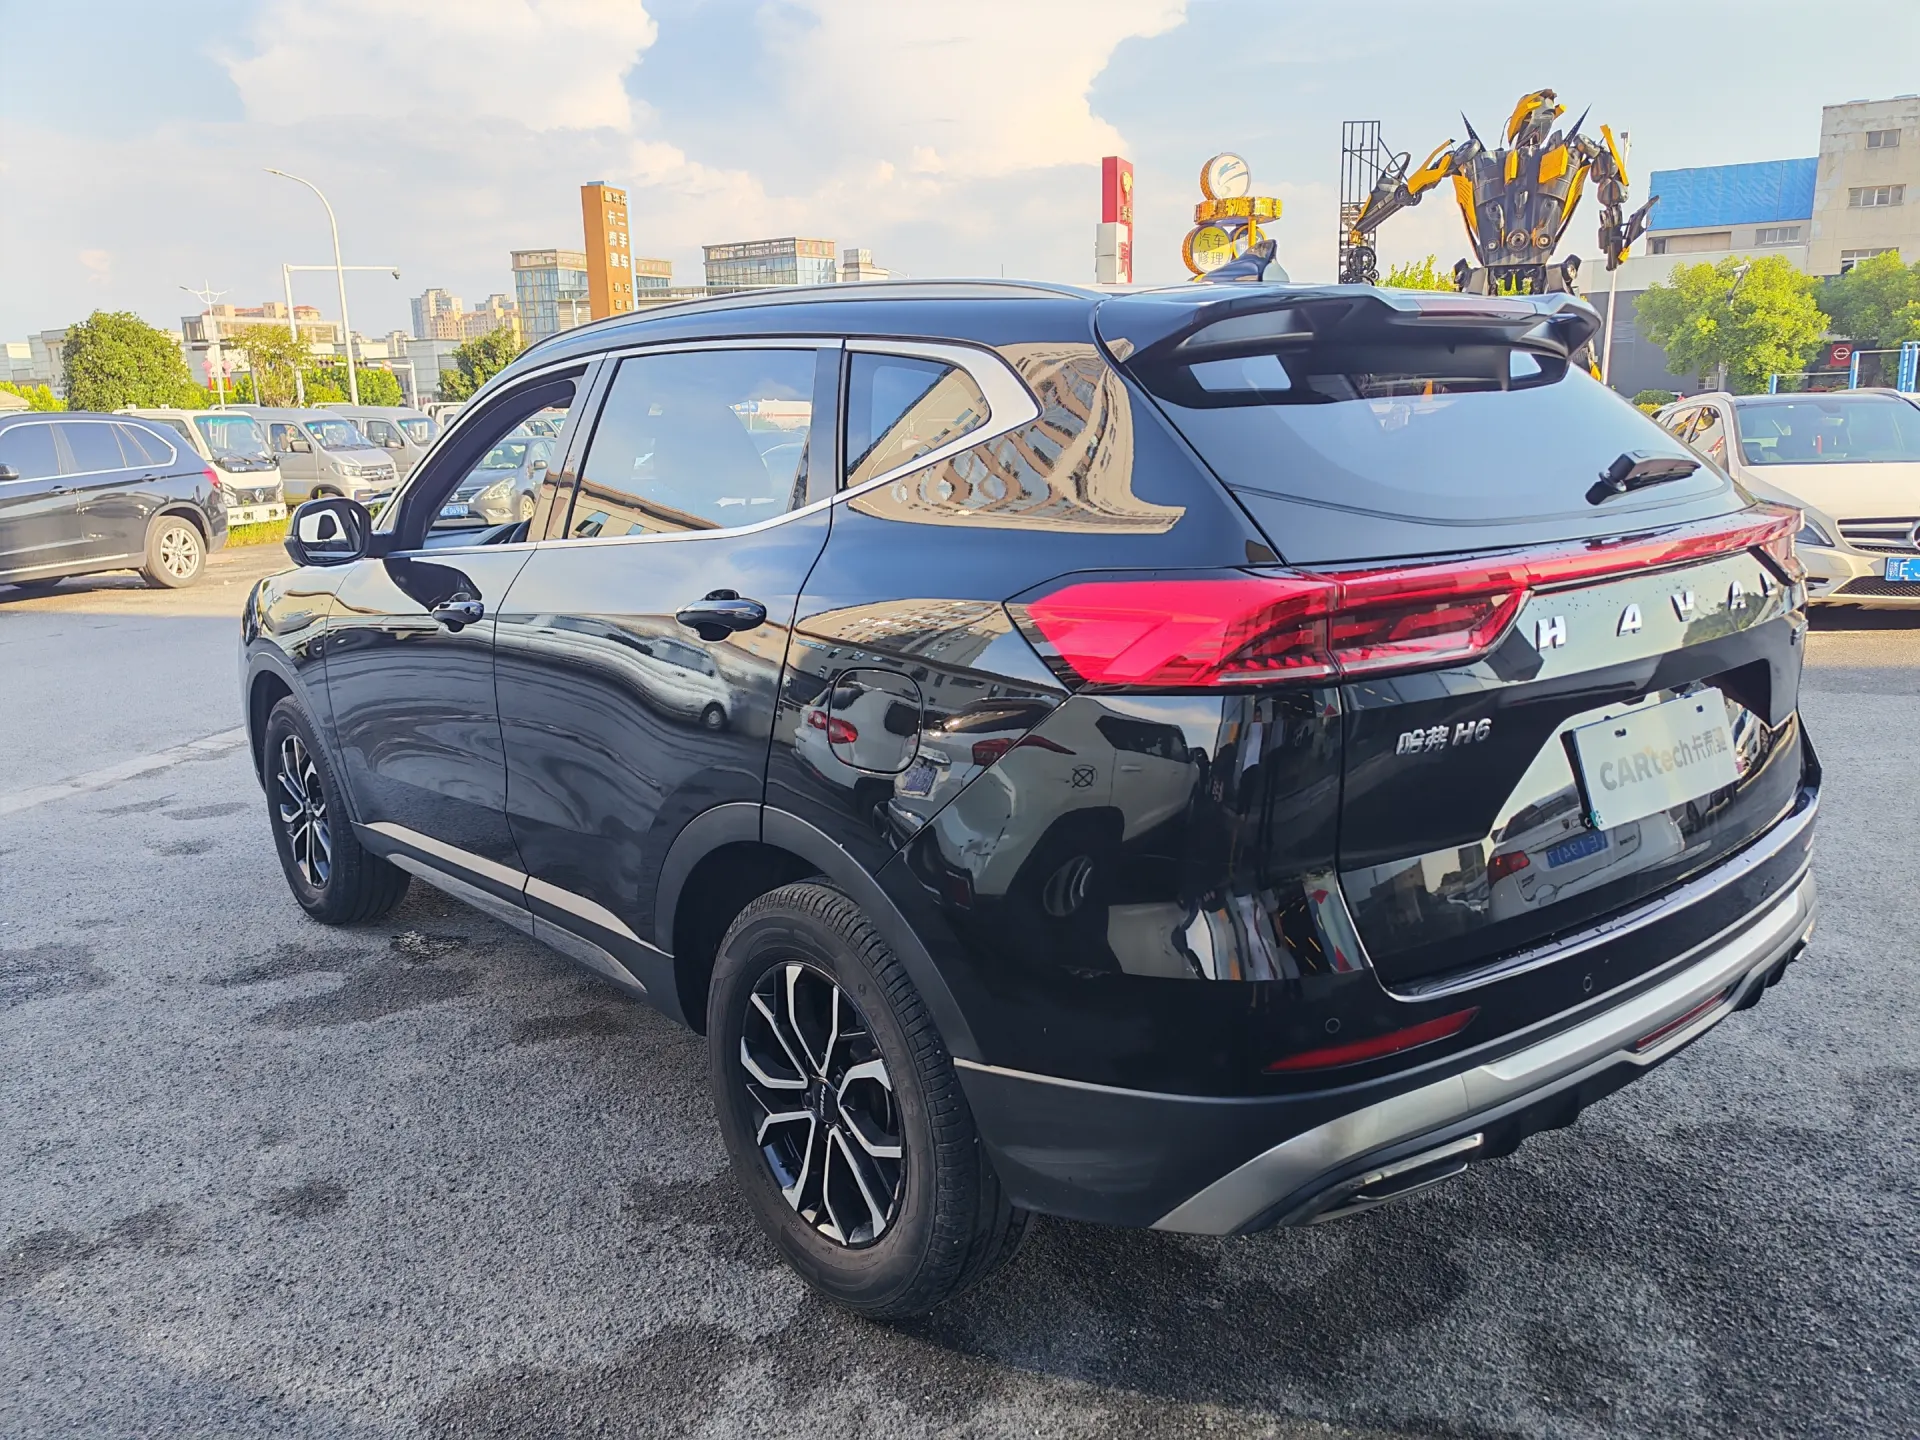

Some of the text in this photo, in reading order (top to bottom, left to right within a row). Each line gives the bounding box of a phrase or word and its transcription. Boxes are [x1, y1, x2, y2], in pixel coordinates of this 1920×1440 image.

[617, 212, 629, 269] 二手车
[1198, 233, 1225, 248] 汽车
[1198, 251, 1224, 265] 修理
[1534, 572, 1780, 651] HAVAL
[1396, 717, 1492, 755] 哈弗 H6
